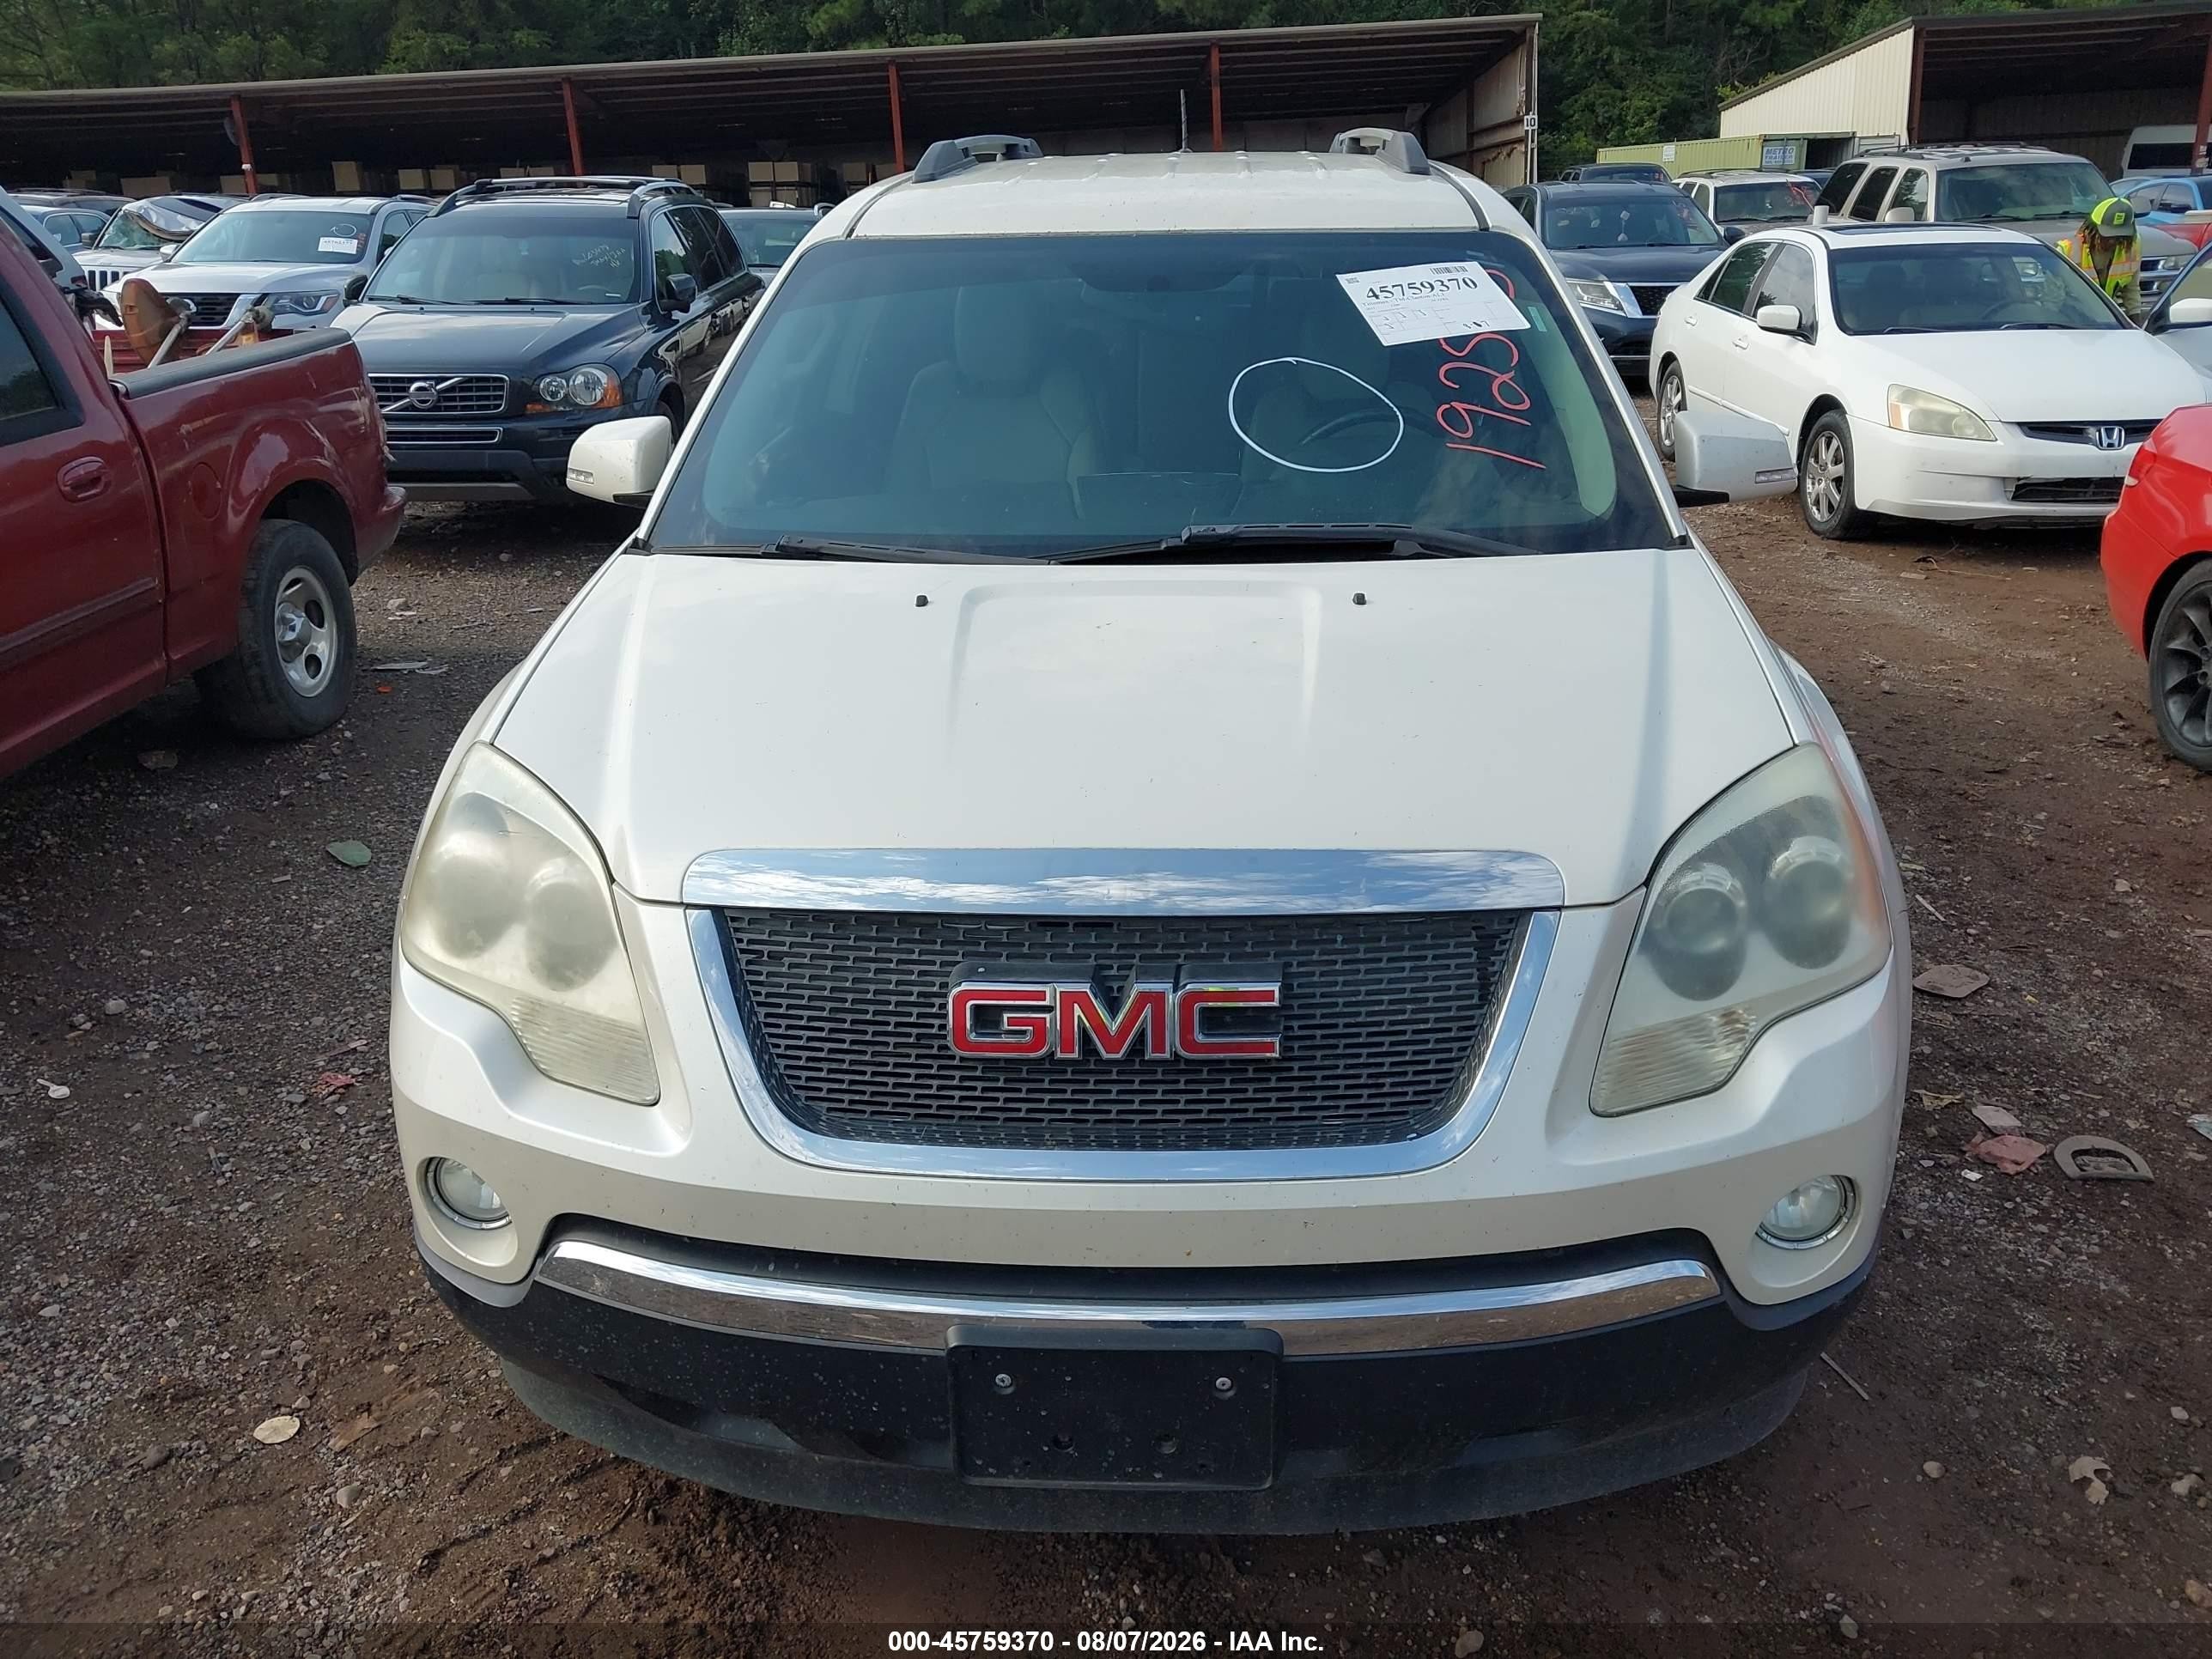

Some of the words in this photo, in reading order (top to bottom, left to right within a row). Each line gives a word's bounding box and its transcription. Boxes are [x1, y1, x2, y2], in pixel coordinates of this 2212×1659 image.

[1526, 117, 1536, 127] 10
[1366, 276, 1478, 300] 45759370
[948, 981, 1282, 1060] GMC
